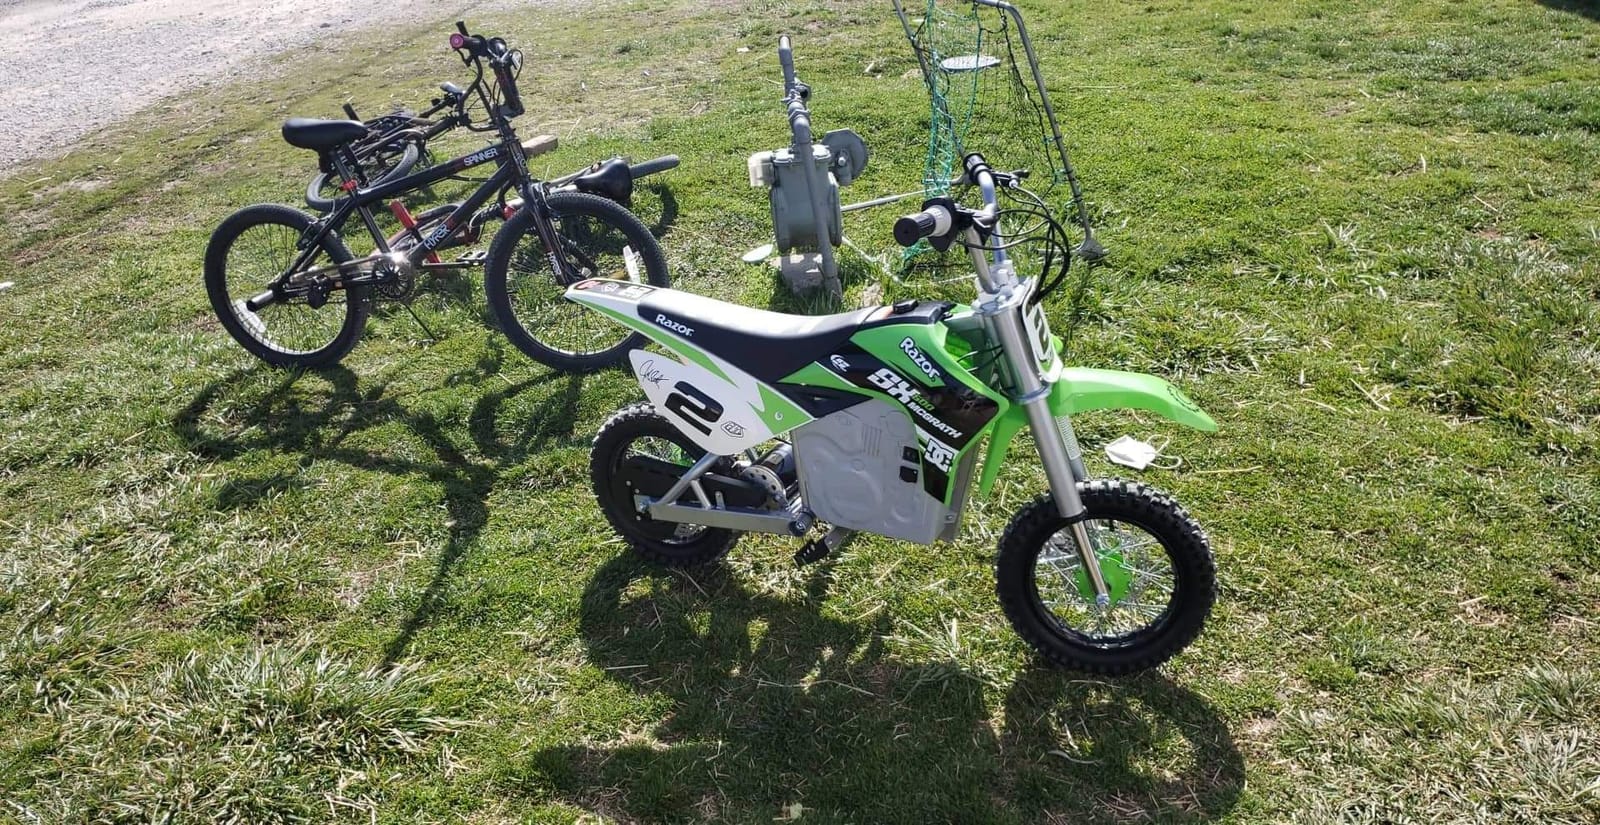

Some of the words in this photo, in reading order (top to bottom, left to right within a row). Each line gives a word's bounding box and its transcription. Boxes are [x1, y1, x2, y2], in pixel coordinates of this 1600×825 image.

[463, 147, 499, 167] SPINNER
[655, 313, 695, 336] Razor
[900, 337, 940, 379] Razor
[664, 380, 724, 437] 2
[907, 401, 963, 439] MCGRATH
